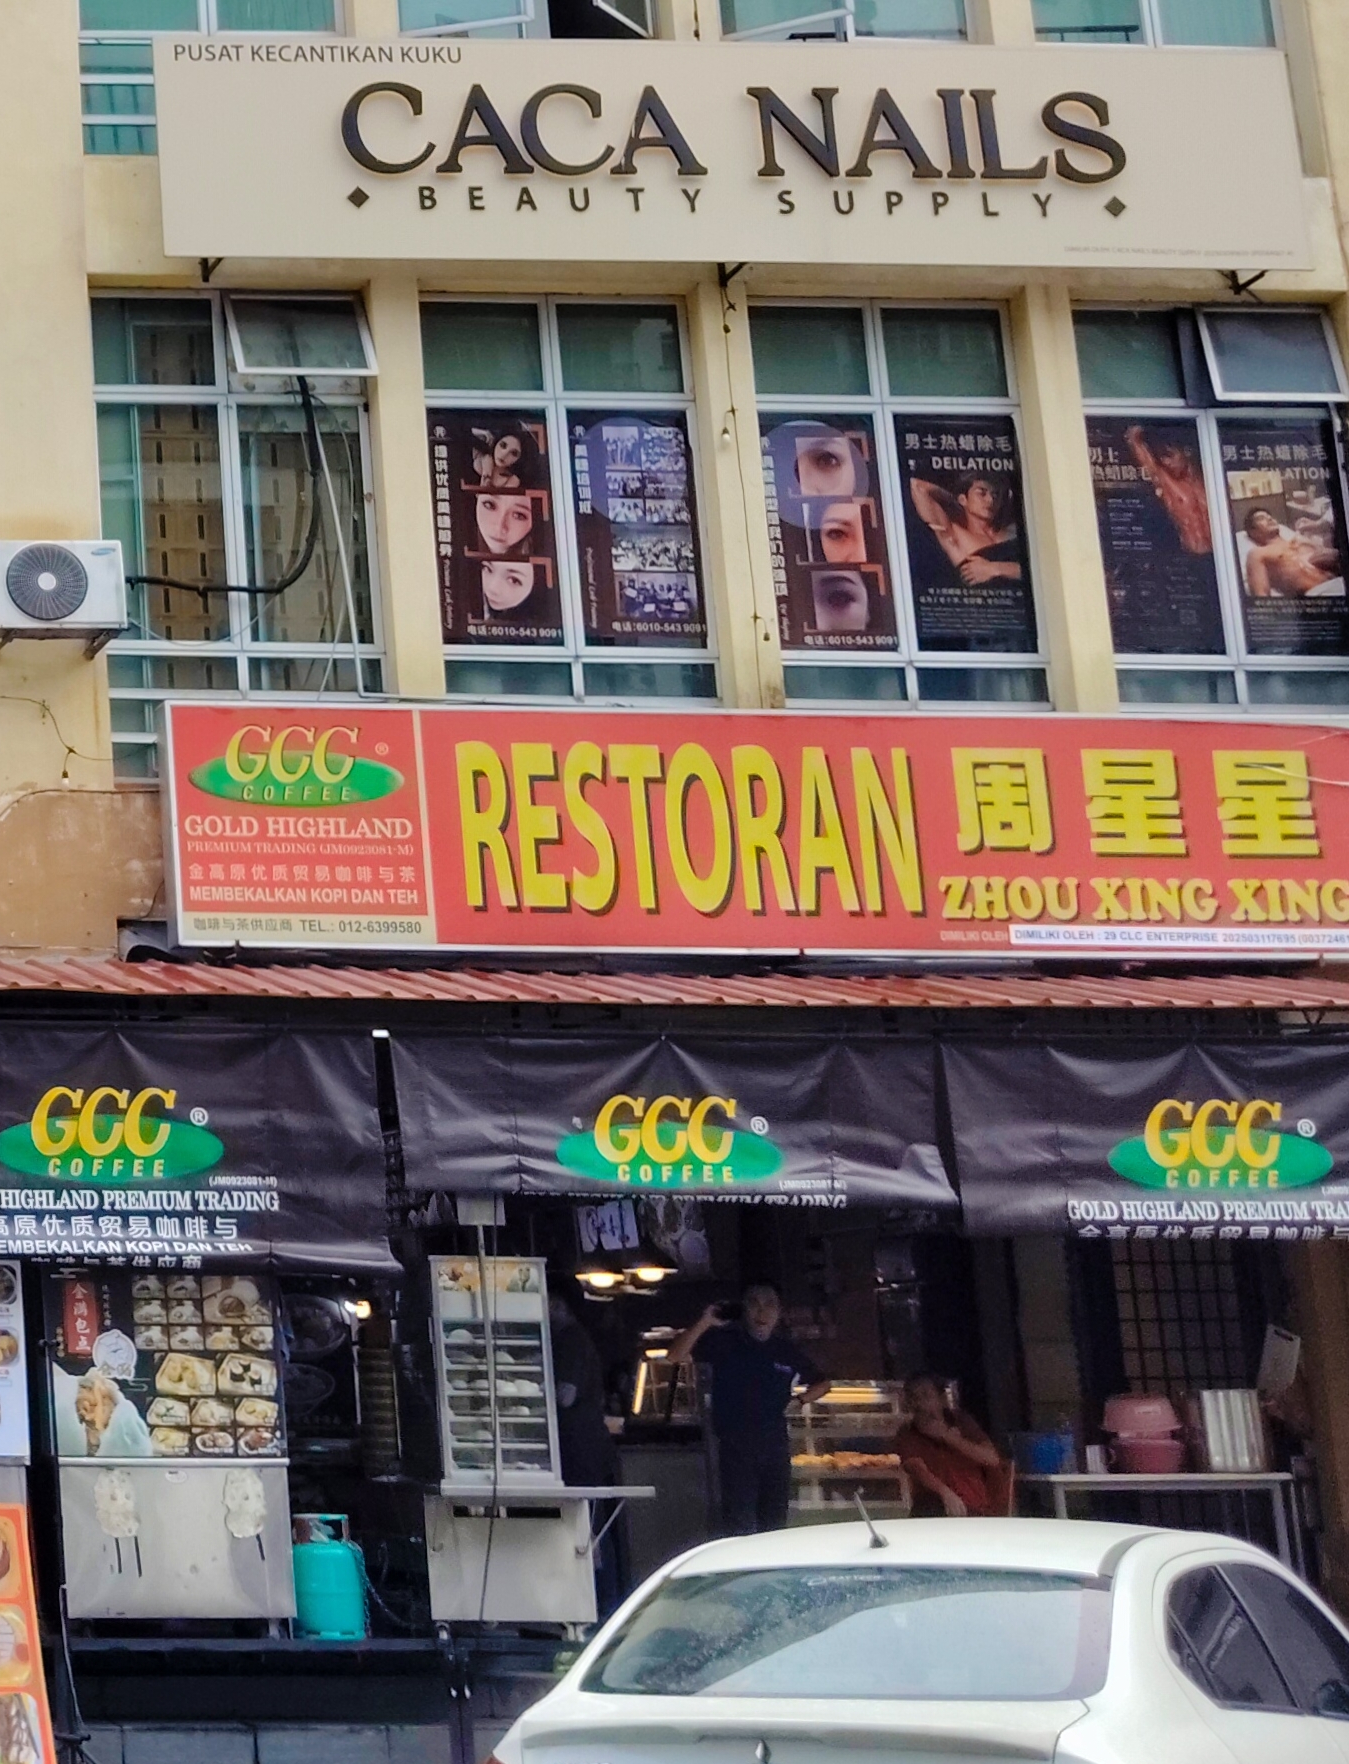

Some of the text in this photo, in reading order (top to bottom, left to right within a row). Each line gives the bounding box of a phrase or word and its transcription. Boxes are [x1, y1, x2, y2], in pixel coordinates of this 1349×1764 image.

[173, 44, 462, 64] PUSAT KECANTIKAN KUKU
[340, 81, 1128, 186] CACA NAILS
[418, 185, 1055, 219] BEAUTY SUPPLY
[931, 456, 1015, 472] DEILATION
[538, 626, 563, 638] 9091
[682, 622, 707, 634] 9091
[875, 635, 898, 646] 9091
[225, 724, 363, 785] GCC
[242, 785, 352, 802] COFFEE
[951, 747, 1321, 857] 周星星
[184, 815, 413, 840] GOLD HIGHLAND
[455, 741, 923, 916] RESTORAN
[186, 841, 250, 854] PREMIUM
[254, 842, 318, 856] TRADING
[188, 863, 416, 884] 金高原优质贸易咖啡与茶
[189, 886, 418, 905] MEMBEKALKAN KOPI DAN TEH
[938, 875, 1349, 924] ZHOU XING XING
[193, 917, 293, 934] 咖啡与茶供应商
[338, 919, 422, 936] 012-6399580
[1014, 929, 1061, 941] DIMILIKI
[1062, 930, 1094, 941] OLEH
[1104, 931, 1117, 941] 29
[1119, 931, 1143, 942] CLC
[1146, 931, 1219, 943] ENTERPRISE
[31, 1086, 177, 1157] GCC
[594, 1094, 737, 1165] GCC
[1144, 1098, 1282, 1169] GCC
[48, 1158, 165, 1178] COFFEE
[617, 1164, 735, 1183] COFFEE
[1165, 1169, 1280, 1188] COFFEE
[0, 1189, 99, 1211] HIGHLAND
[101, 1190, 193, 1211] PREMIUM
[194, 1191, 280, 1211] TRADING
[1068, 1200, 1118, 1221] GOLD
[1121, 1200, 1219, 1222] HIGHLAND
[1223, 1201, 1309, 1222] PREMIUM
[124, 1240, 170, 1254] KOPI
[173, 1241, 211, 1253] DAN
